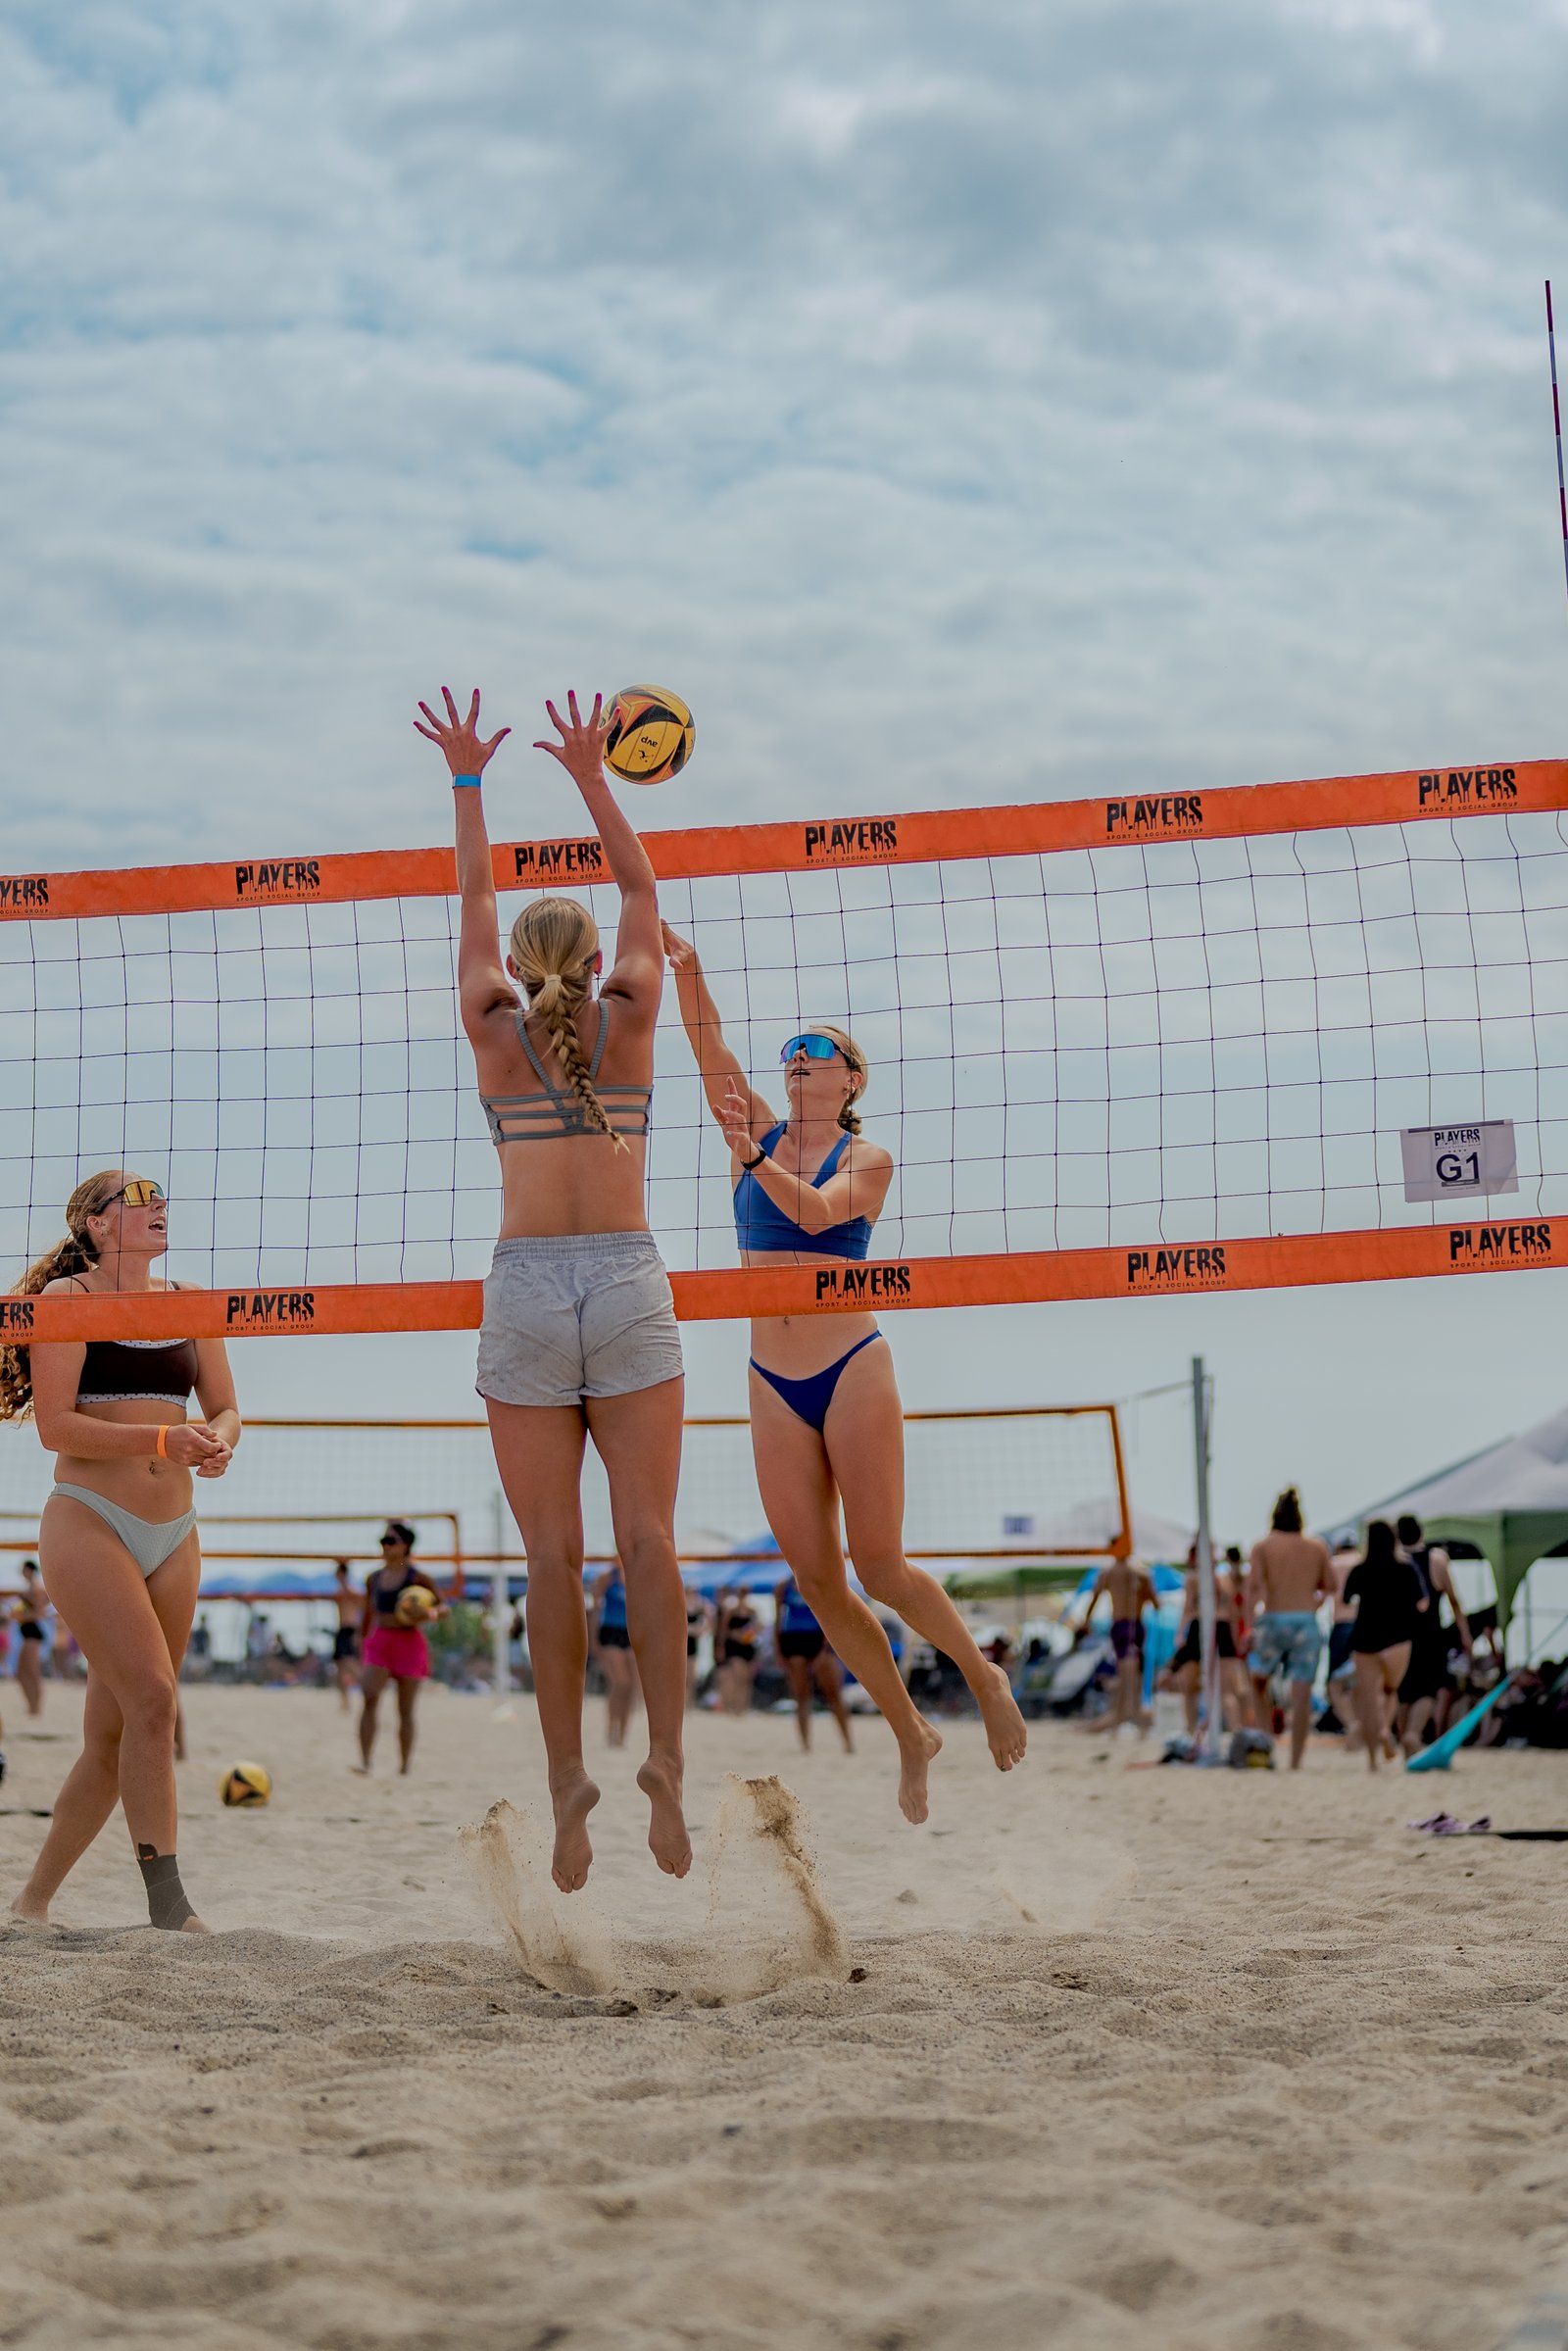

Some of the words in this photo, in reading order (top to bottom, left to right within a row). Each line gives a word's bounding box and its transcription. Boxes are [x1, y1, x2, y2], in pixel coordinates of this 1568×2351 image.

[641, 736, 659, 748] avp
[1419, 768, 1517, 806] PLAYERS
[1106, 796, 1202, 832] PLAYERS
[806, 820, 897, 856] PLAYERS
[514, 841, 602, 876] PLAYERS
[235, 860, 319, 895] PLAYERS
[1435, 1129, 1480, 1147] PLAYERS
[1436, 1151, 1480, 1182] G1
[1449, 1223, 1551, 1260] PLAYERS
[816, 1266, 910, 1299] PLAYERS
[1128, 1247, 1225, 1283] PLAYERS
[227, 1293, 315, 1324] PLAYERS
